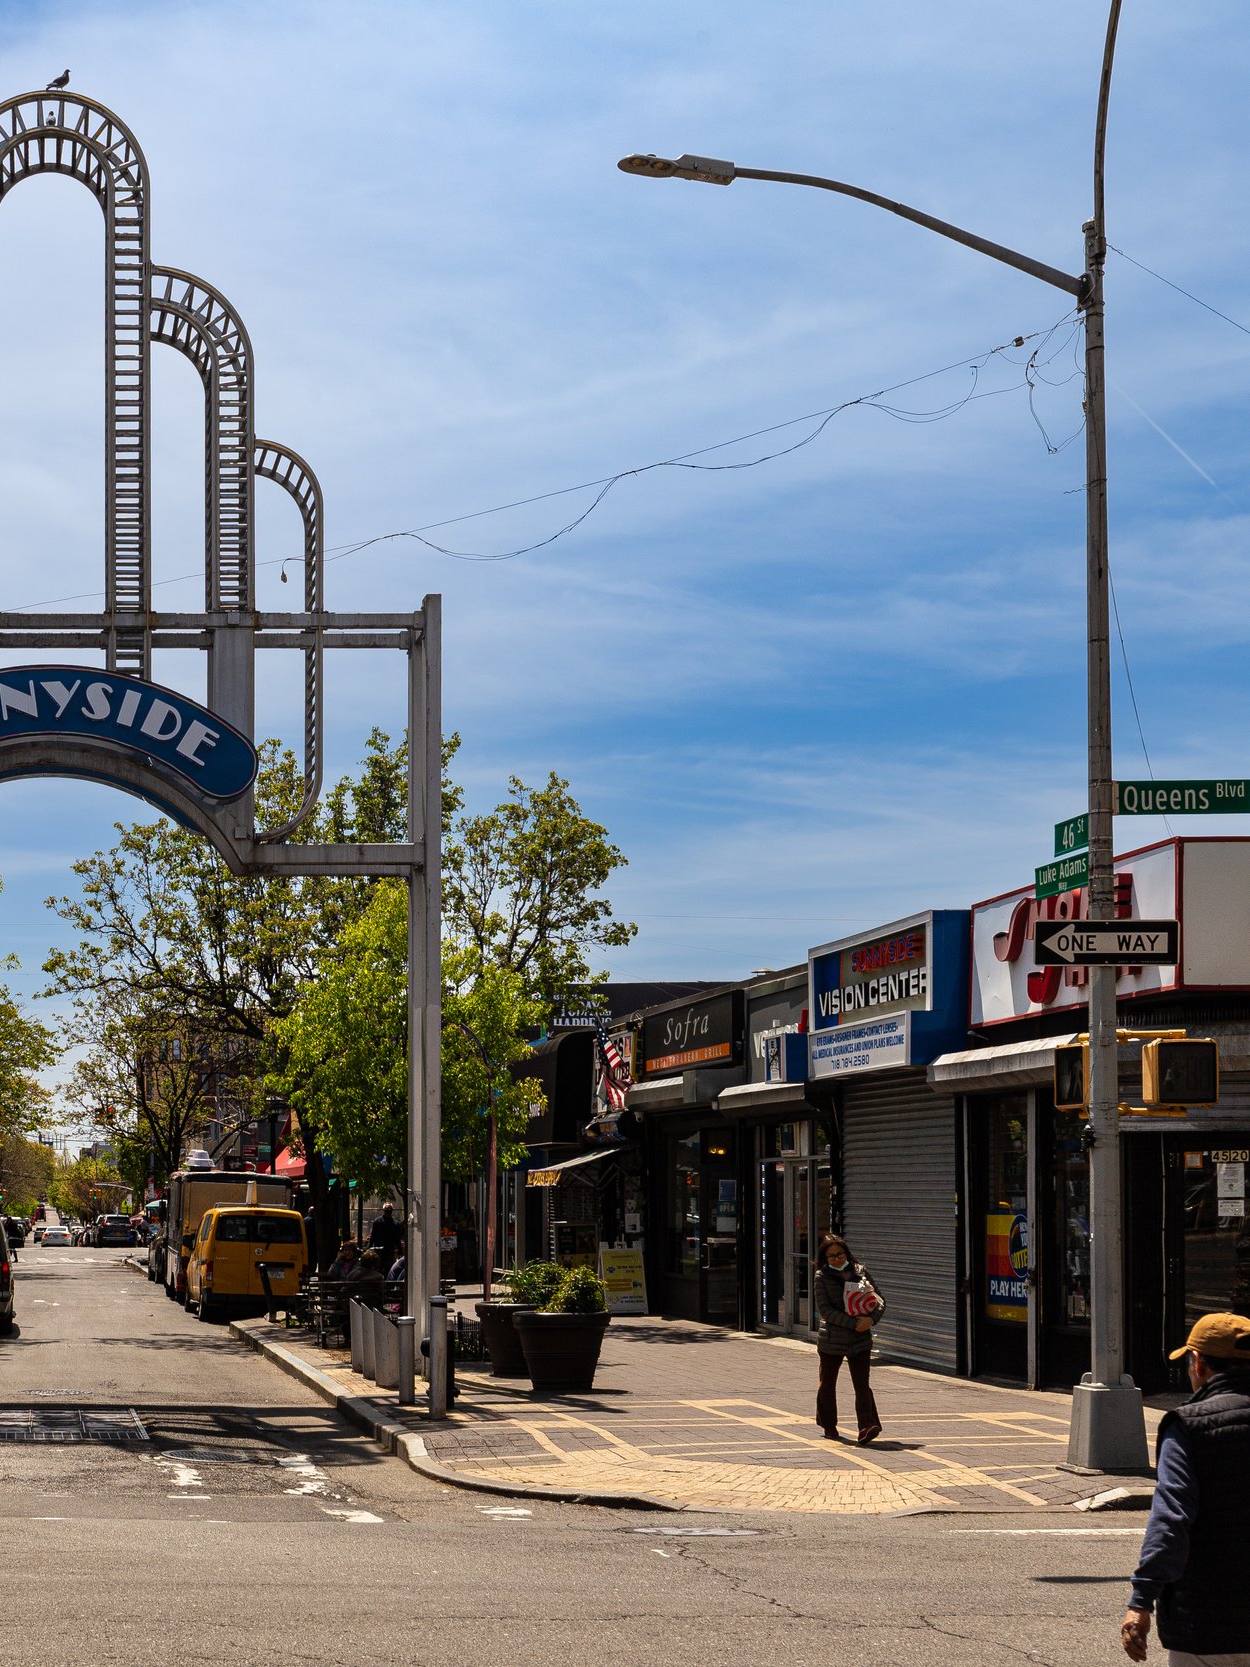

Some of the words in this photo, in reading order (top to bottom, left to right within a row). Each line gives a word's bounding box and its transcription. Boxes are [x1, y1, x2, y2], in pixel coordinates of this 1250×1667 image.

[1124, 785, 1210, 813] Queens
[1216, 782, 1245, 798] Blvd
[1062, 823, 1075, 850] 46
[1077, 817, 1085, 833] St
[1039, 866, 1057, 886] Luke
[1059, 857, 1087, 880] Adams
[851, 933, 916, 973] SUNNYSIDE
[1057, 935, 1097, 951] ONE
[1117, 934, 1161, 951] WAY
[819, 982, 865, 1017] VISION
[664, 1008, 709, 1049] Sofra
[831, 1054, 870, 1070] 718.784.2580
[1213, 1151, 1248, 1161] 4520
[990, 1280, 1010, 1297] PLAY
[1011, 1281, 1027, 1298] HER
